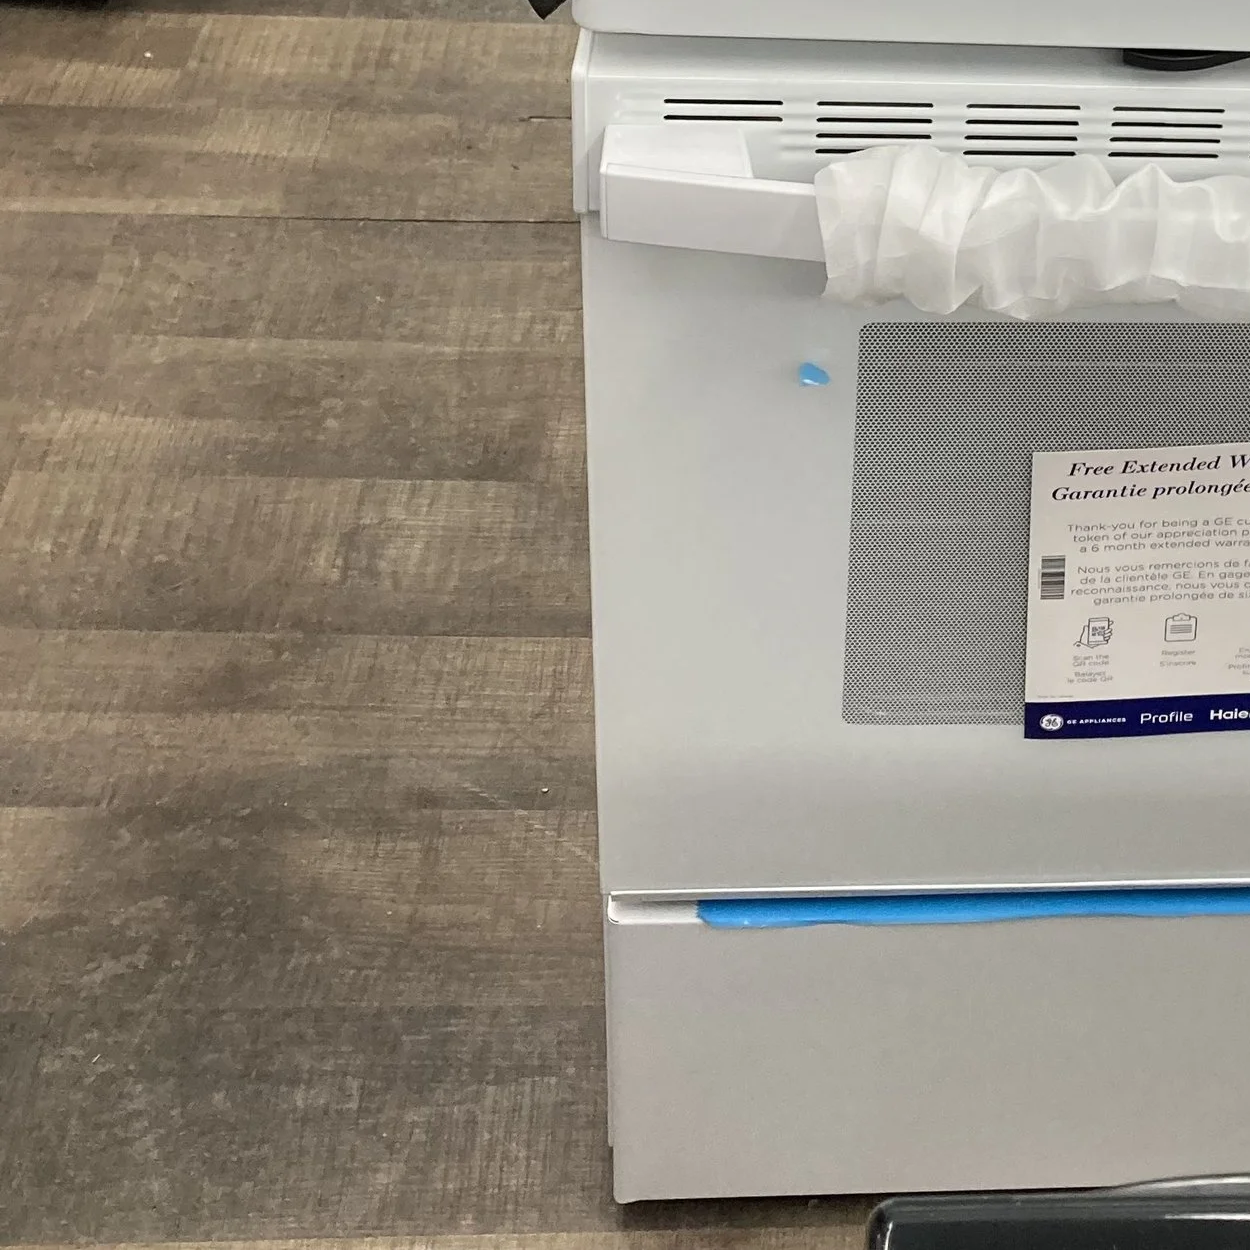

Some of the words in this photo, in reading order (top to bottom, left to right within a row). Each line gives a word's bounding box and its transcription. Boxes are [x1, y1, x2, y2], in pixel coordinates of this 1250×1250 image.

[1067, 462, 1114, 476] Free
[1120, 456, 1221, 474] Extended
[1052, 484, 1147, 501] Garantie
[1068, 522, 1135, 532] Thank-you
[1140, 520, 1158, 529] for
[1162, 519, 1198, 528] being
[1202, 519, 1210, 527] a
[1214, 517, 1233, 526] GE
[1073, 534, 1109, 543] token
[1113, 532, 1127, 541] of
[1131, 532, 1152, 540] our
[1157, 528, 1237, 539] appreciation
[1091, 544, 1099, 552] 6
[1104, 542, 1146, 551] month
[1150, 539, 1210, 550] extended
[1077, 566, 1111, 574] Nous
[1115, 564, 1145, 572] vous
[1149, 561, 1219, 570] remercions
[1223, 559, 1240, 568] de
[1080, 576, 1096, 585] de
[1100, 575, 1111, 584] la
[1198, 570, 1215, 579] En
[1218, 571, 1250, 580] gage
[1176, 581, 1206, 590] nous
[1210, 581, 1240, 589] vous
[1093, 595, 1146, 606] garantie
[1149, 591, 1214, 602] prolongée
[1218, 591, 1234, 599] de
[1079, 717, 1126, 725] APPLIANCES
[1140, 711, 1193, 725] Profile
